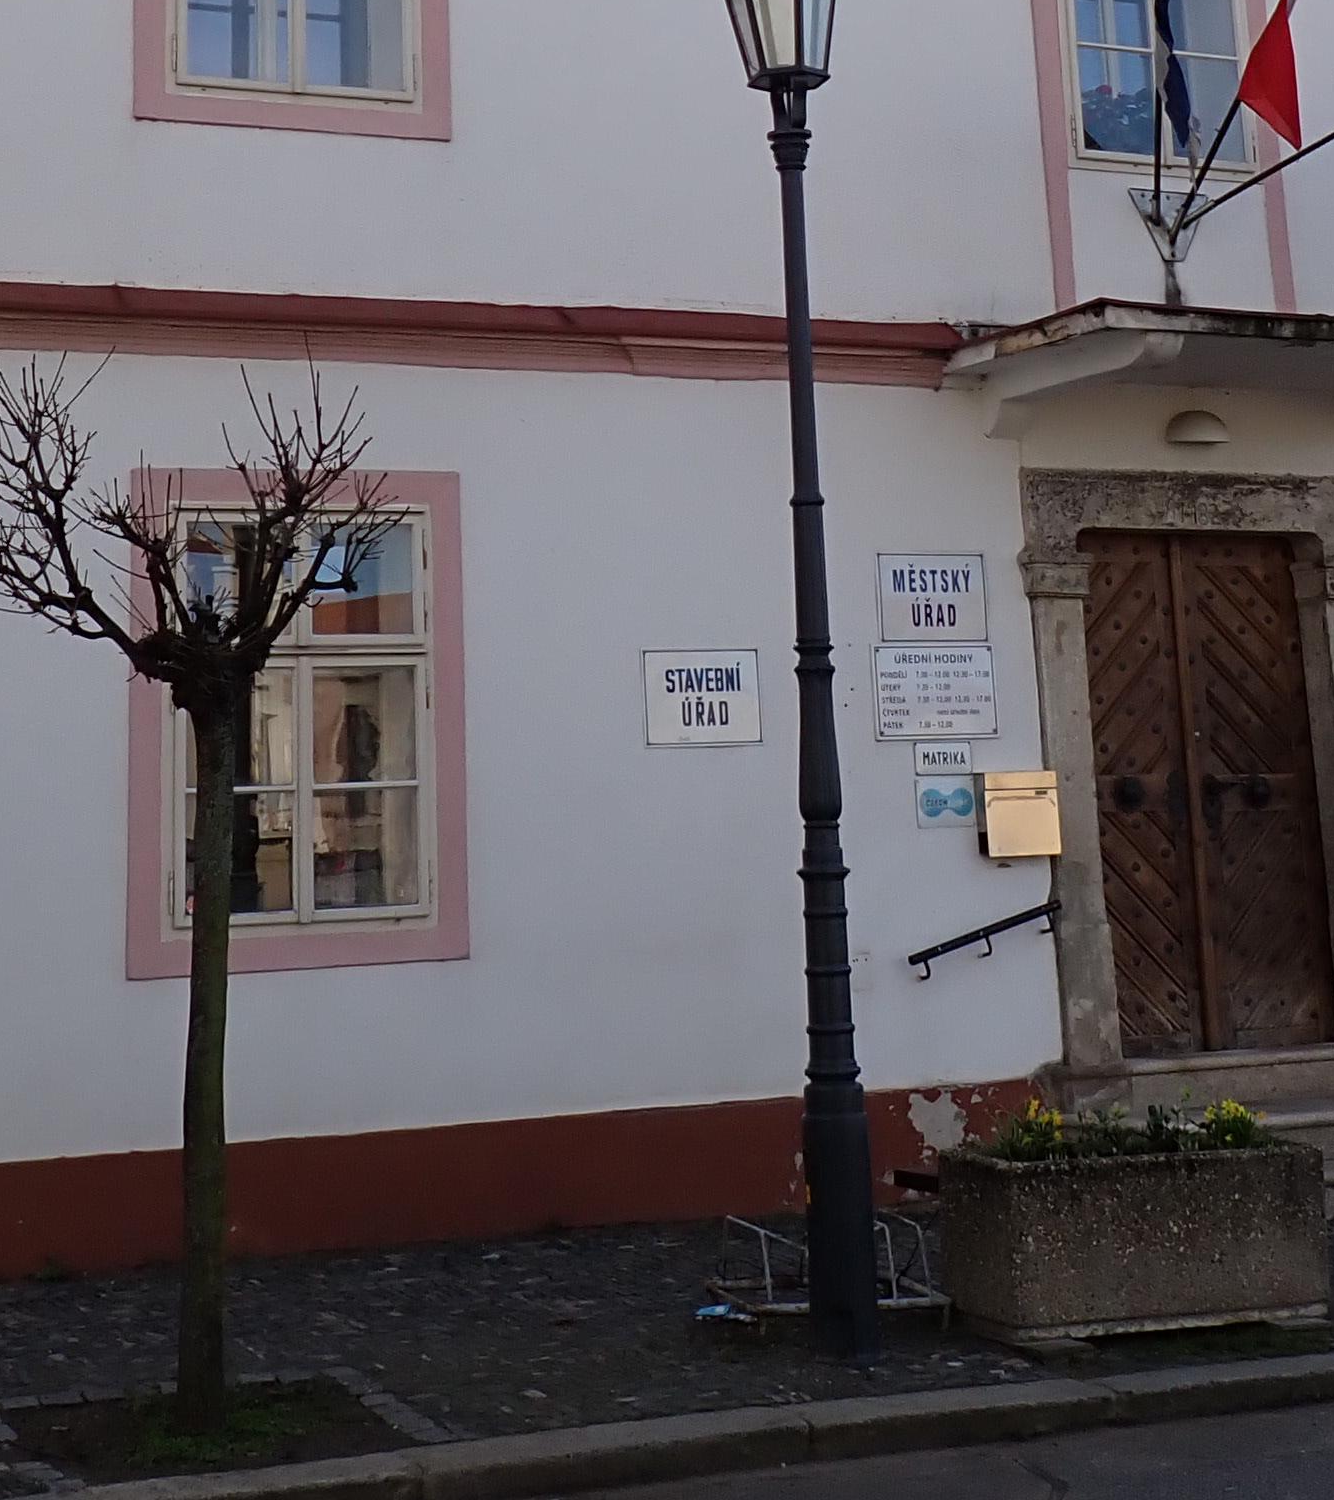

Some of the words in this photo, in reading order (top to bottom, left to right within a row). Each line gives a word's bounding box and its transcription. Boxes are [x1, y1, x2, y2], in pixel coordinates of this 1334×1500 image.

[892, 563, 972, 594] MĚSTSKÝ
[911, 596, 958, 628] ÚŘAD
[893, 652, 932, 664] ÚŘEDNÍ
[934, 653, 973, 664] HODINY
[665, 662, 742, 694] STAVEBNÍ
[681, 695, 730, 727] ÚŘAD
[922, 751, 966, 766] MATRIKA
